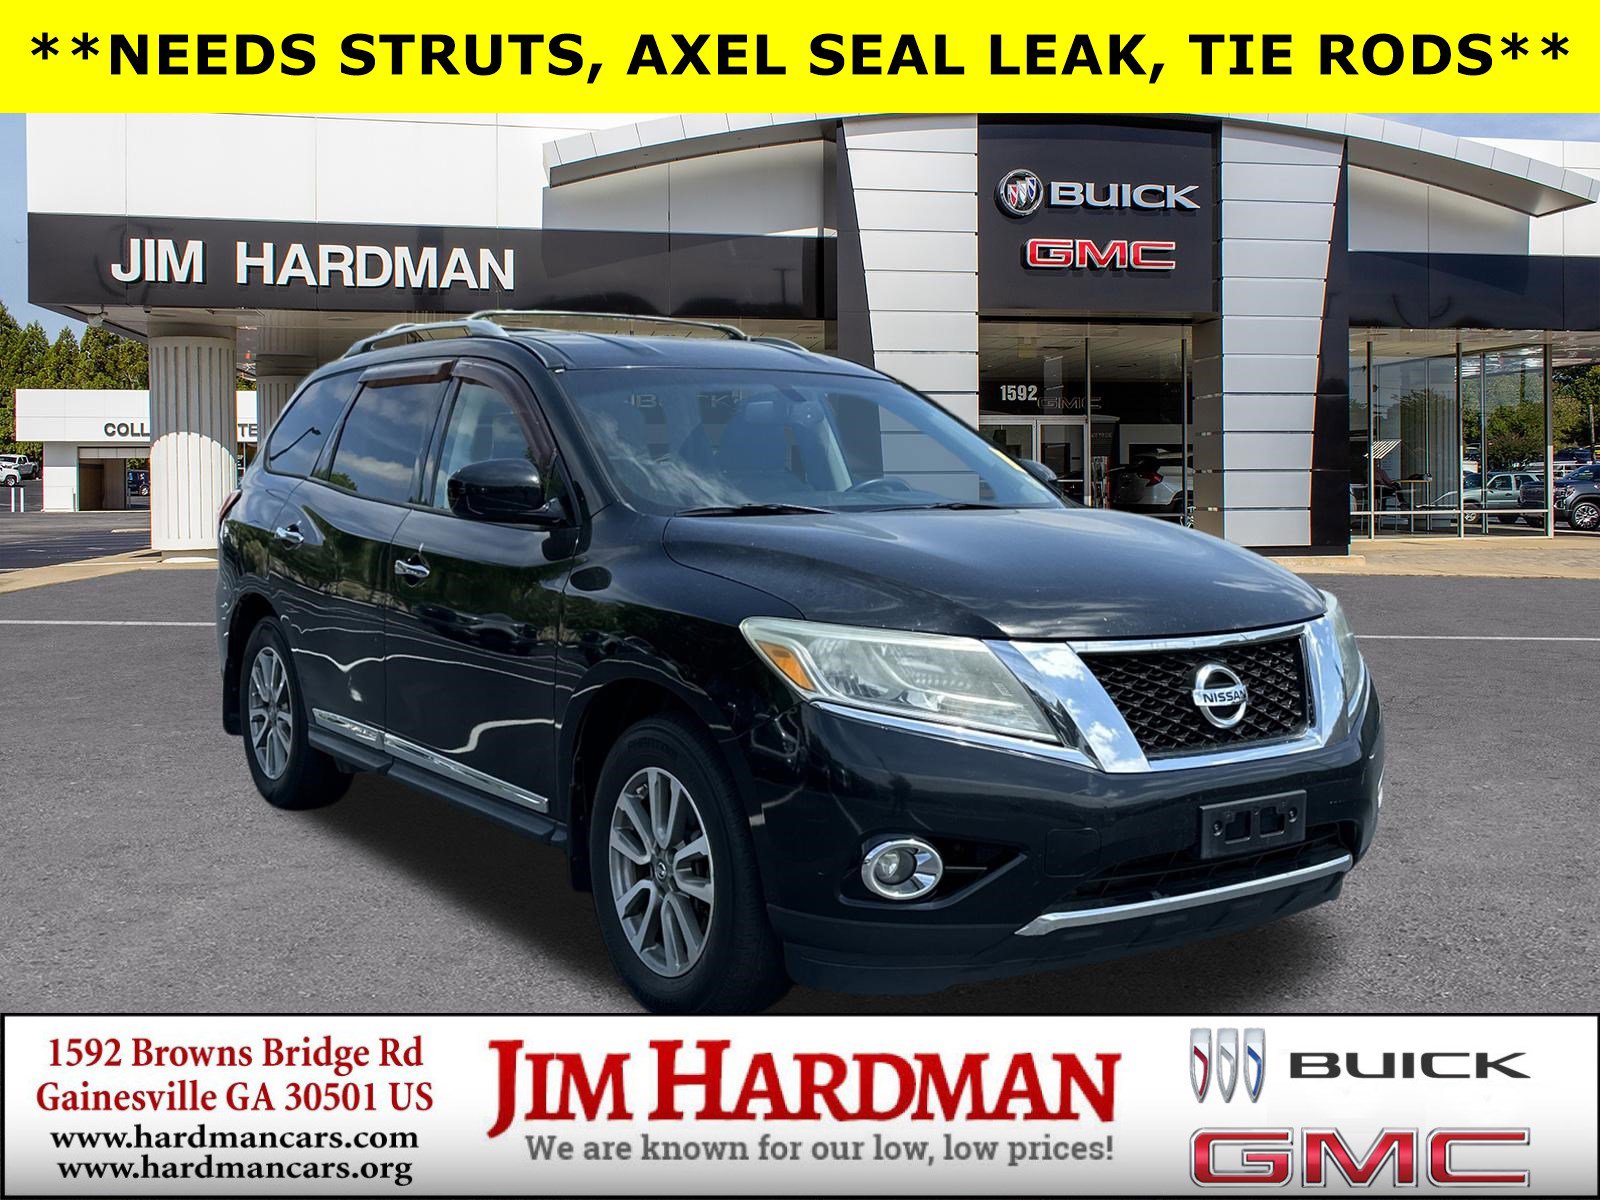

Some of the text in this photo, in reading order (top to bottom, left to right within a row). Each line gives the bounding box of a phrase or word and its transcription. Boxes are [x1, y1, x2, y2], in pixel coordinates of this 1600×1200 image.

[1051, 181, 1200, 209] BUICK
[111, 238, 515, 291] JIM HARDMAN
[1024, 238, 1176, 270] GMC
[1000, 385, 1037, 401] 1592
[1203, 690, 1246, 703] NISSAN
